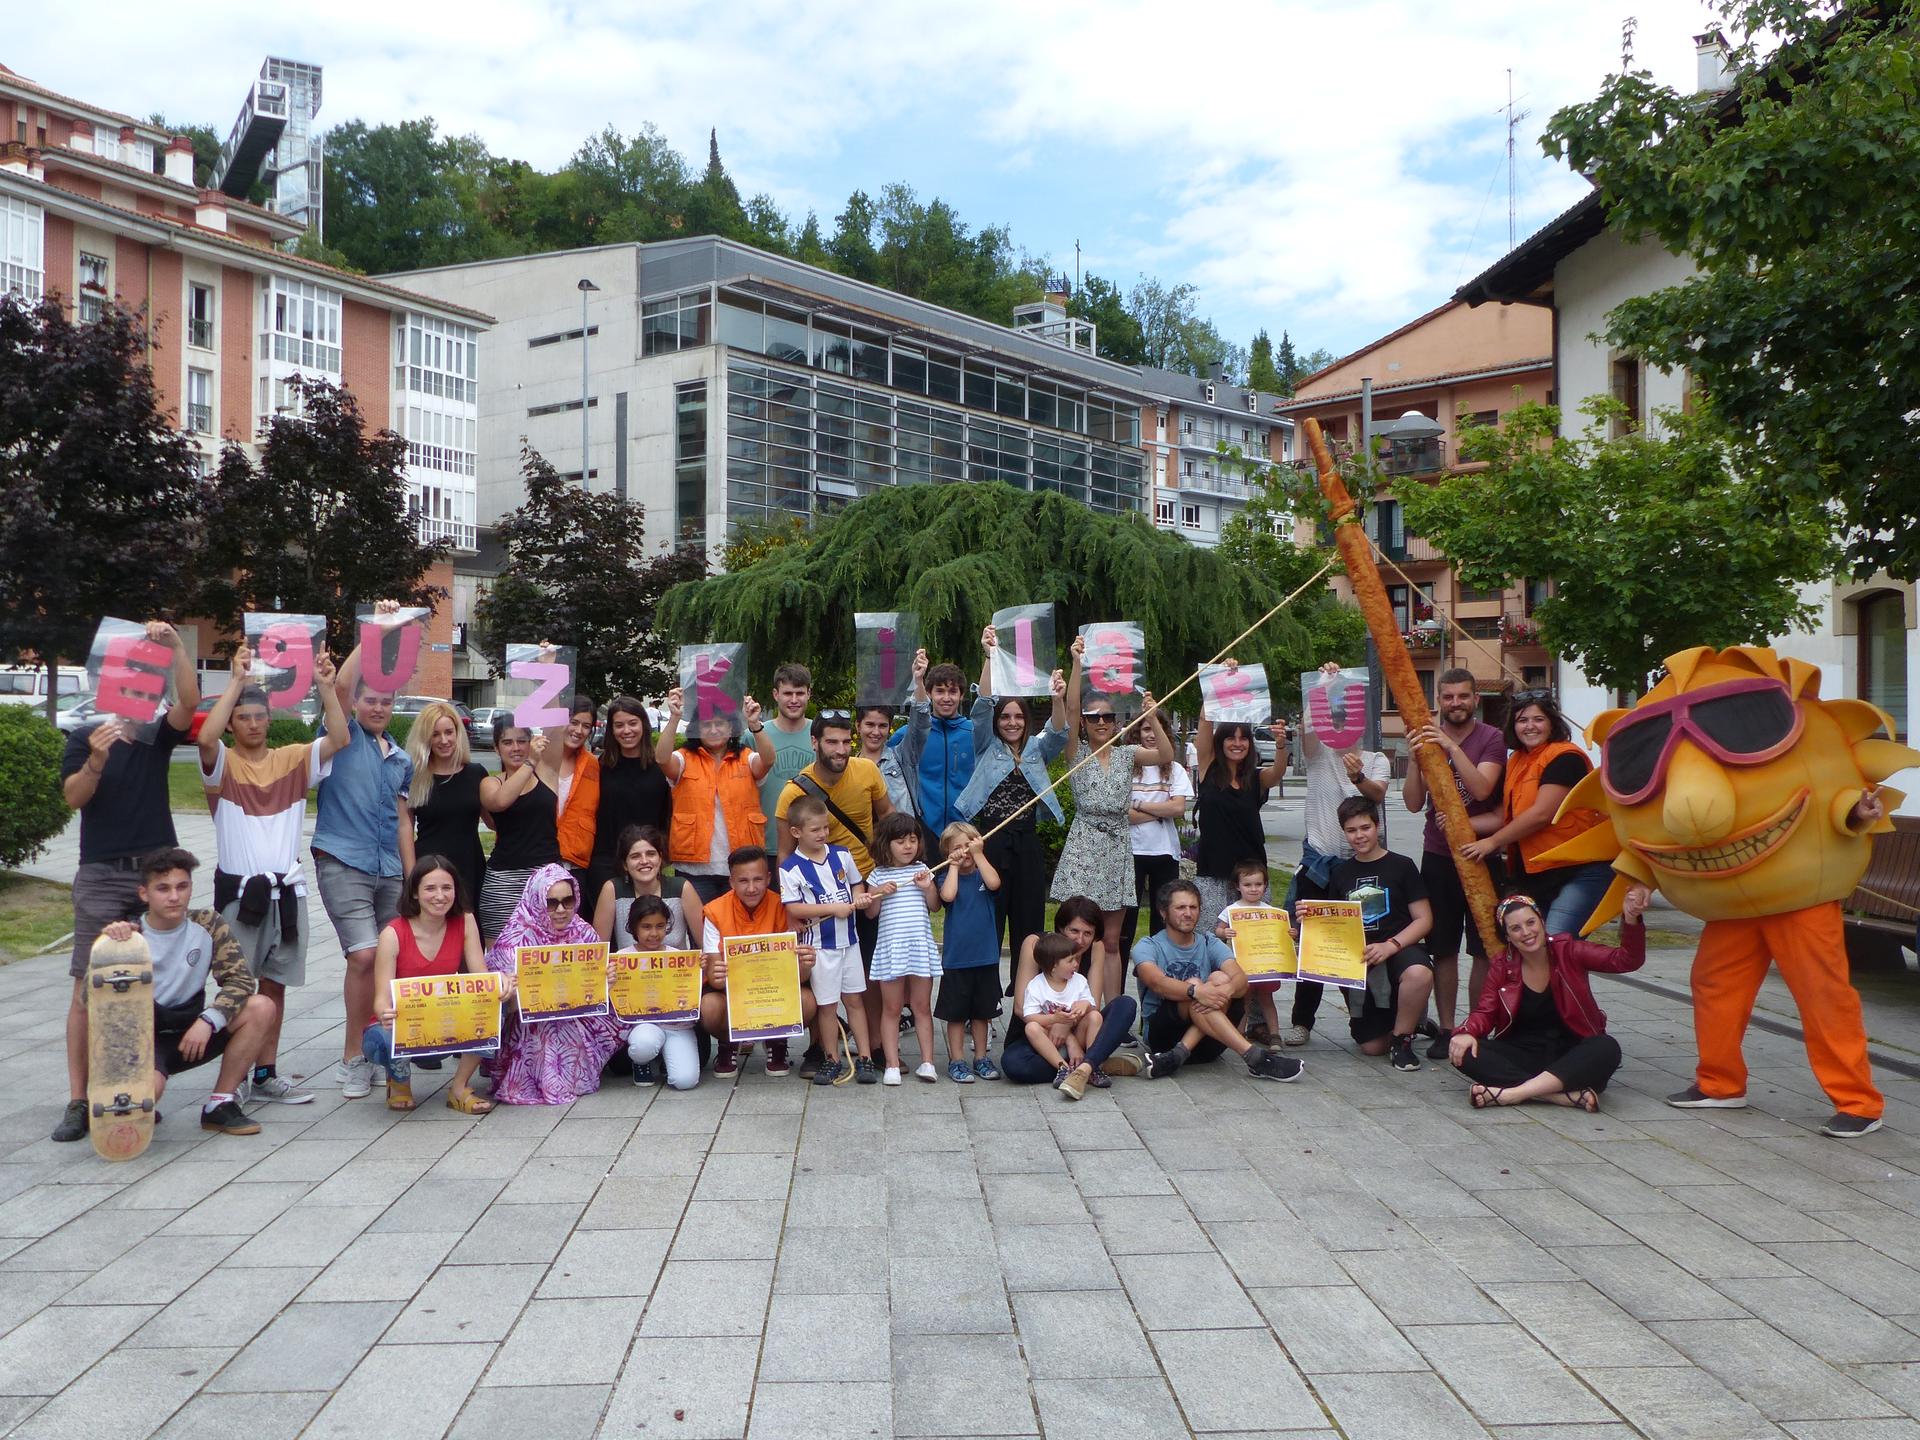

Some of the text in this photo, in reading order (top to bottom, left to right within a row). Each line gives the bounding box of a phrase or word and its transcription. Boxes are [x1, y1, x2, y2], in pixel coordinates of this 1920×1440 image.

[95, 637, 174, 722] E
[360, 623, 422, 693] U
[695, 654, 737, 721] K
[877, 627, 896, 689] i
[1088, 630, 1134, 695] a
[1308, 682, 1366, 750] U
